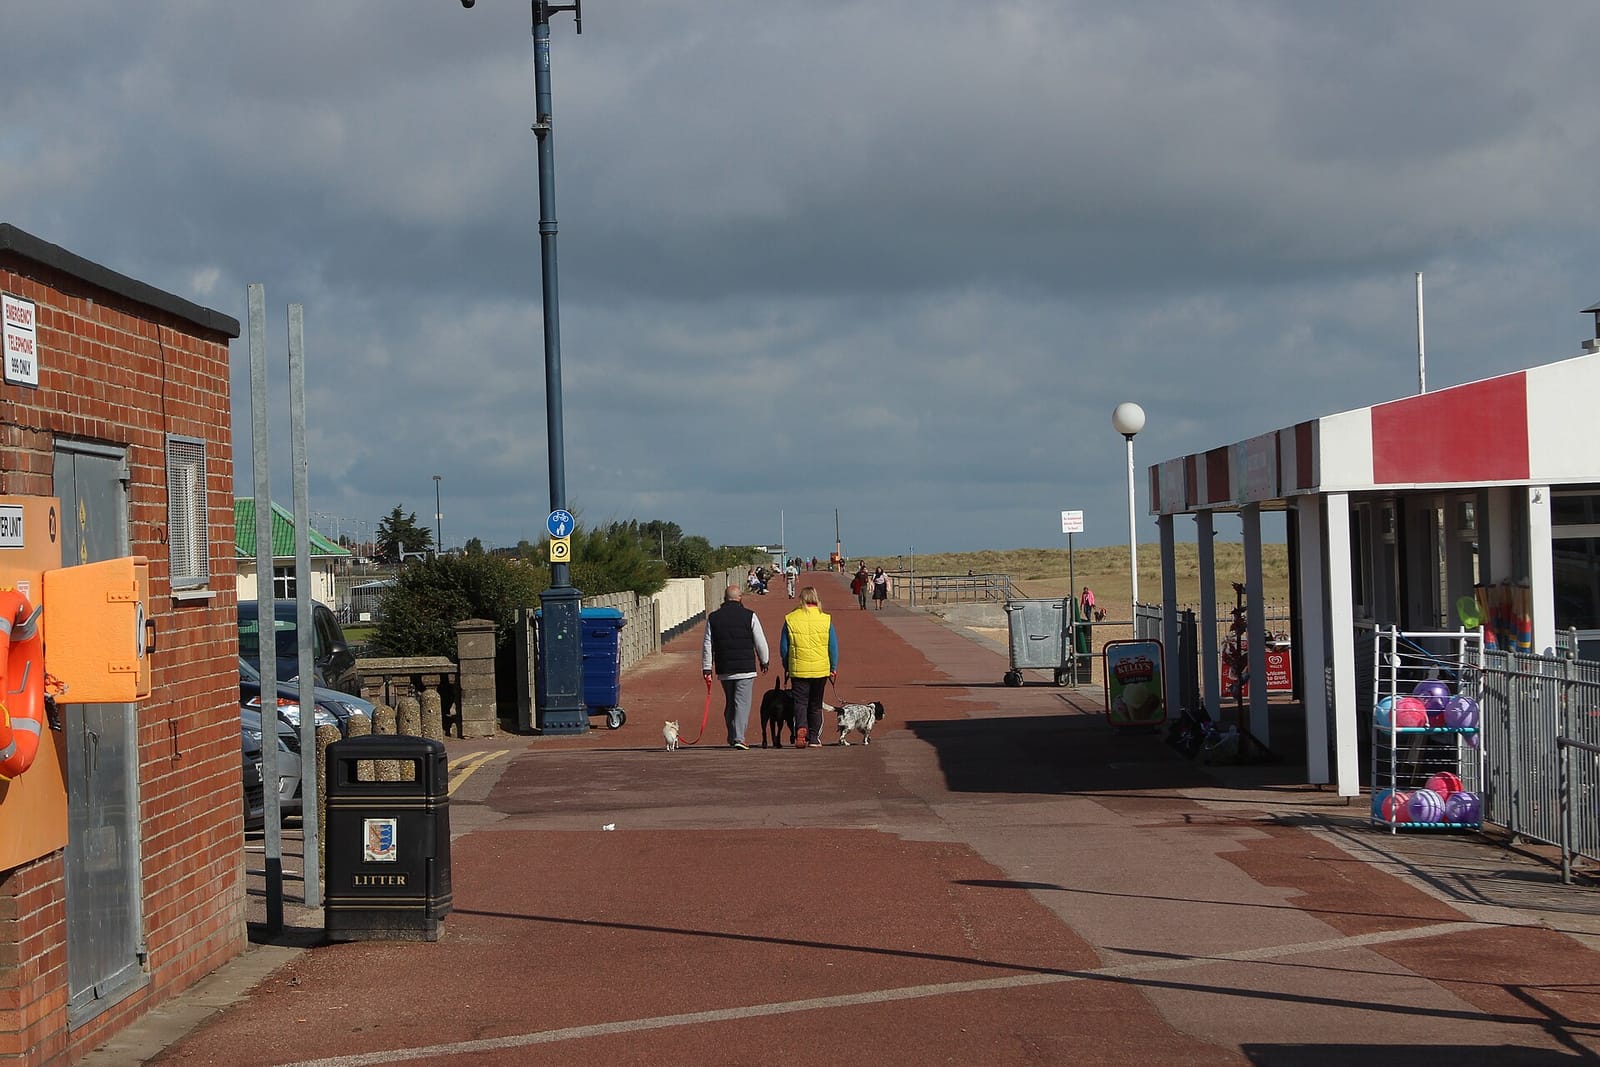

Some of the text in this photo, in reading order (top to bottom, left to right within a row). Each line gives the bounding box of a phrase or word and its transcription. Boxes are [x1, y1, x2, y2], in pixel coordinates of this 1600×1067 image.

[6, 303, 32, 326] EMERGENCY
[8, 334, 33, 355] TELEPHONE
[20, 359, 31, 376] ONLY
[0, 516, 9, 537] ER
[354, 875, 406, 885] LITTER
